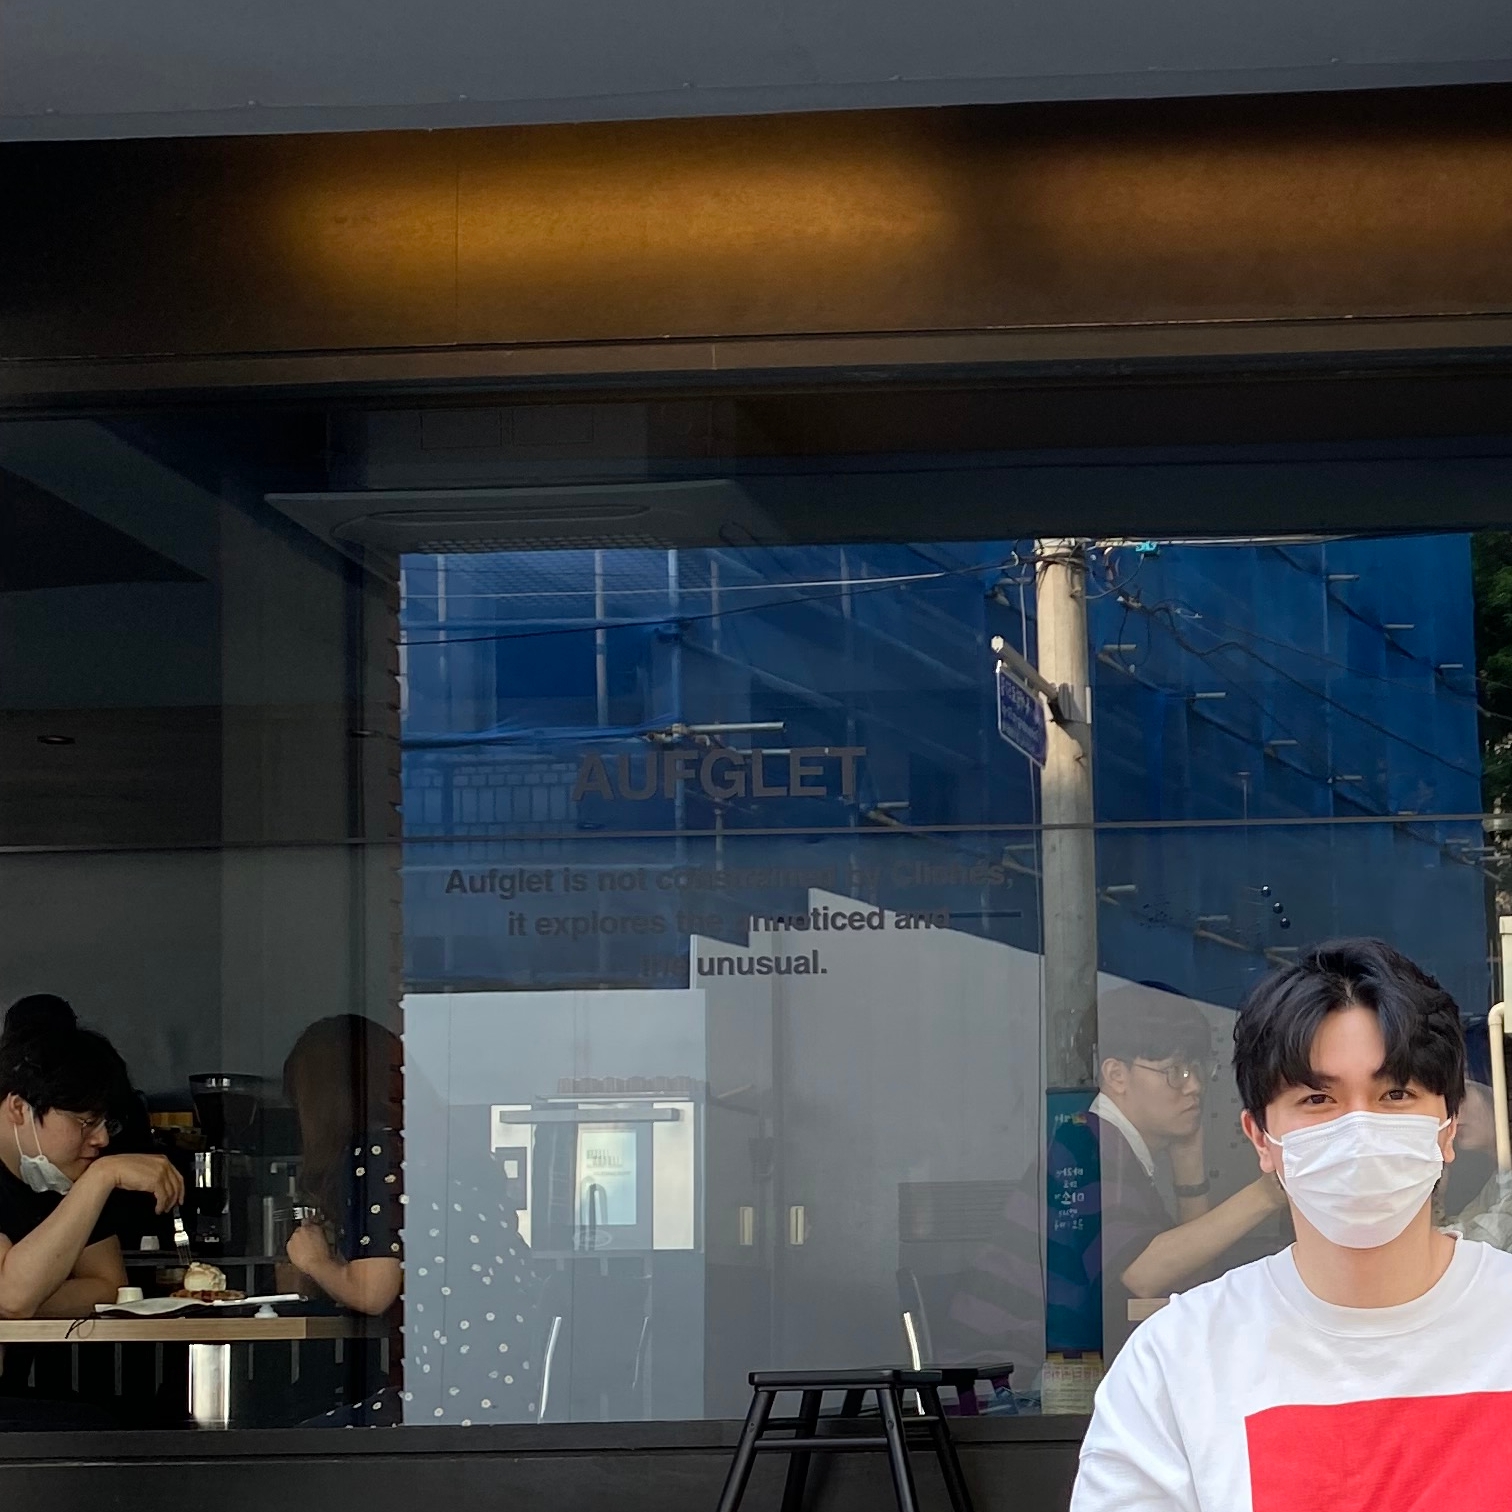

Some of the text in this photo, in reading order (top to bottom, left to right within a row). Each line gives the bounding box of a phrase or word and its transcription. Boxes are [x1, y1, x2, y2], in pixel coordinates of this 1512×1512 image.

[572, 746, 867, 802] AUFGLET
[445, 868, 554, 899] Aufglet
[563, 867, 587, 892] is
[597, 868, 649, 892] not
[509, 911, 528, 937] it
[534, 910, 666, 940] explores
[894, 907, 951, 930] and
[697, 950, 828, 976] unusual.
